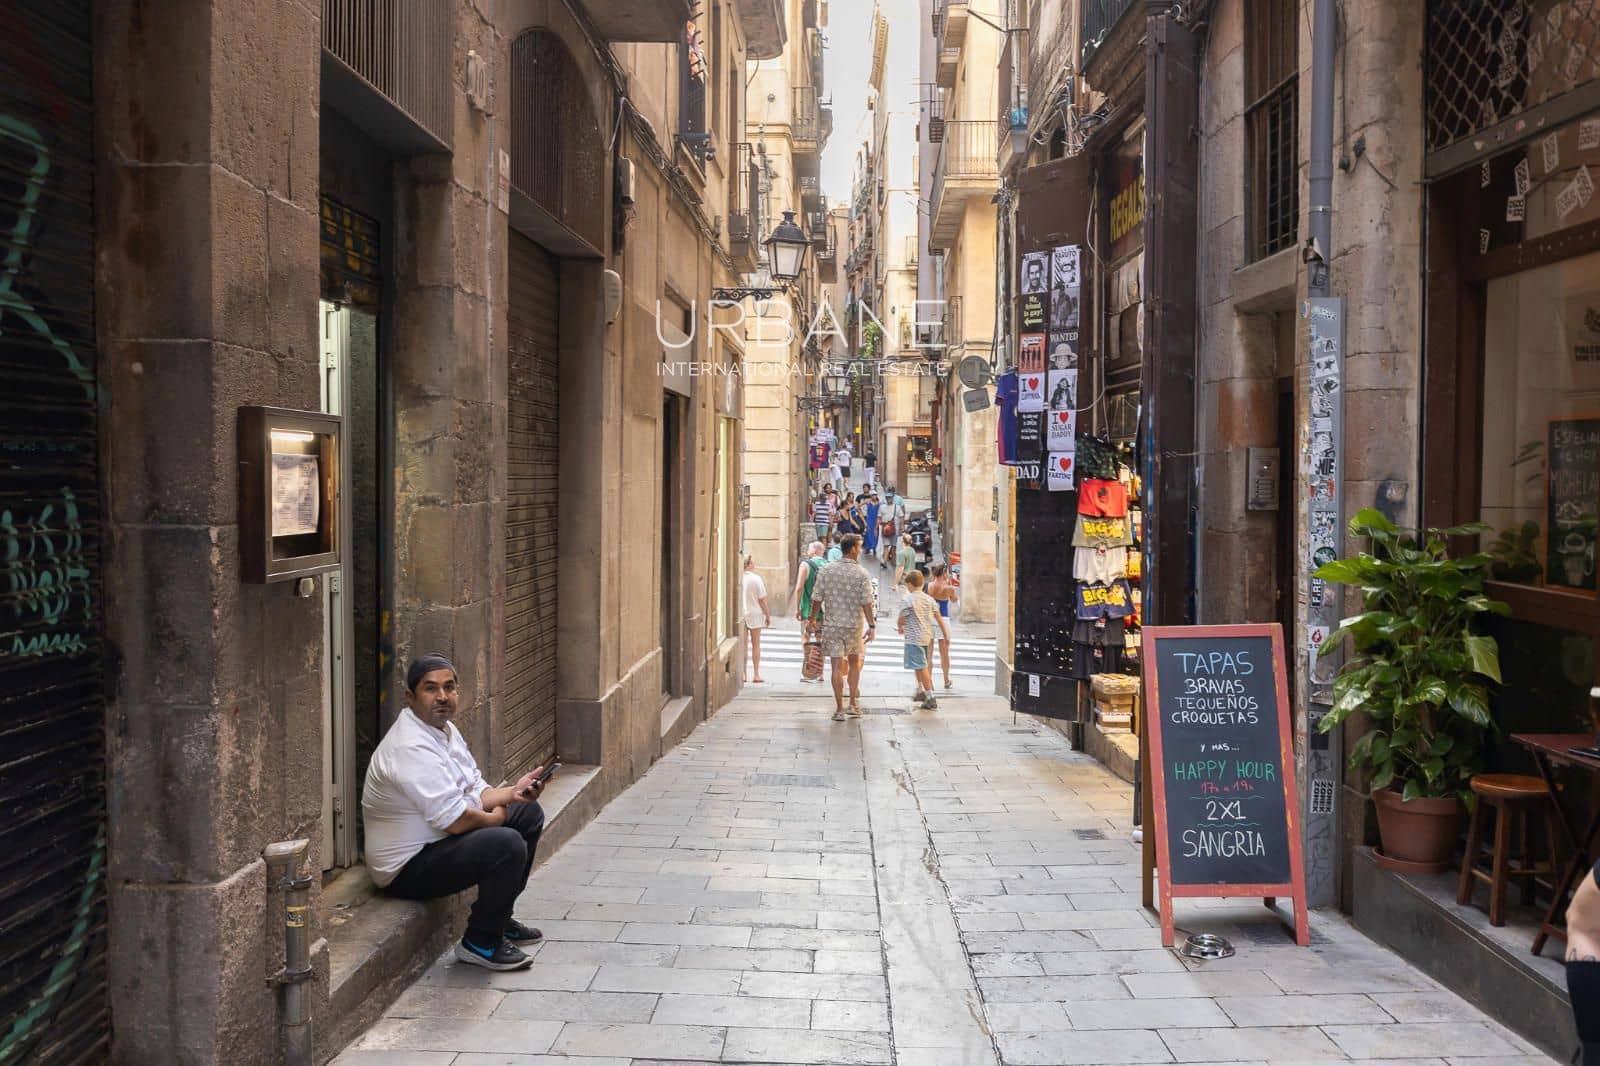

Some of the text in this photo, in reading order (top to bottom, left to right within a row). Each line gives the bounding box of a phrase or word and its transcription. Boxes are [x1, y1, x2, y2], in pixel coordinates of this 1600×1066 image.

[1110, 174, 1145, 243] REGALS
[1049, 331, 1079, 342] WANTED
[1051, 430, 1072, 438] DADDY
[1016, 464, 1040, 480] DAD
[1173, 651, 1254, 676] TAPAS
[1184, 678, 1246, 695] BRAVAS
[1174, 695, 1259, 711] TEQUEÑOS
[1171, 711, 1259, 725] CROQUETAS
[1174, 759, 1276, 782] HAPPY HOUR
[1181, 829, 1266, 858] SANGRIA
